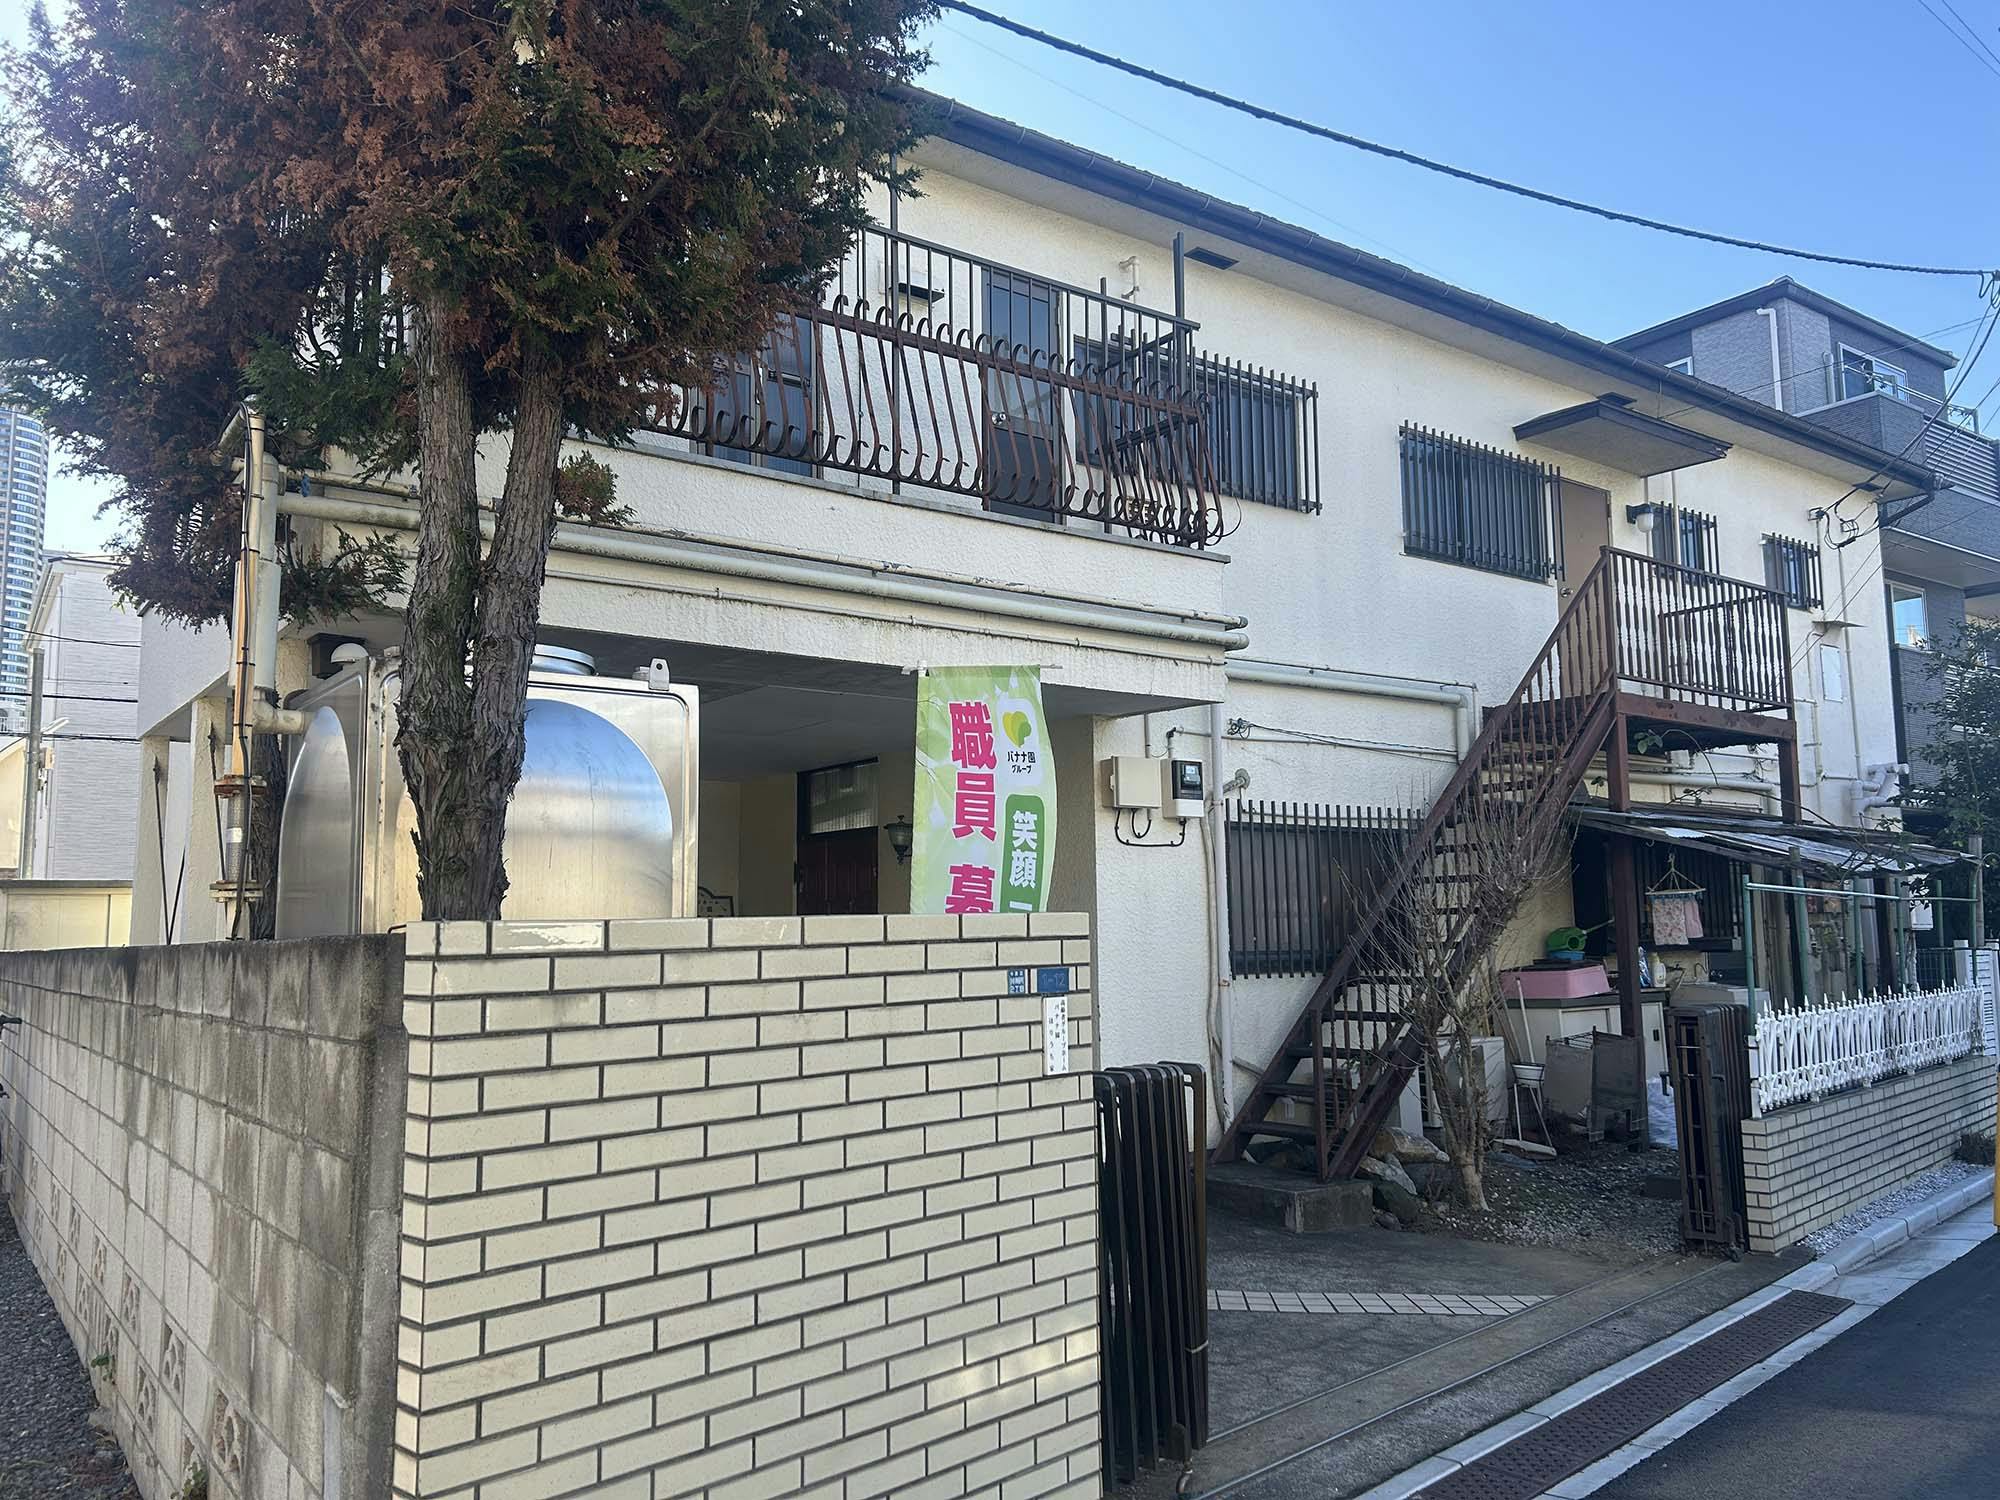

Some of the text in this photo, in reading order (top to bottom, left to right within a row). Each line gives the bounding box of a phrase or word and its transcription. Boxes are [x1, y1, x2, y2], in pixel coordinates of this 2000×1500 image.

[1007, 751, 1035, 763] バナナ園
[1012, 765, 1031, 774] グループ
[1042, 972, 1066, 987] 1-12
